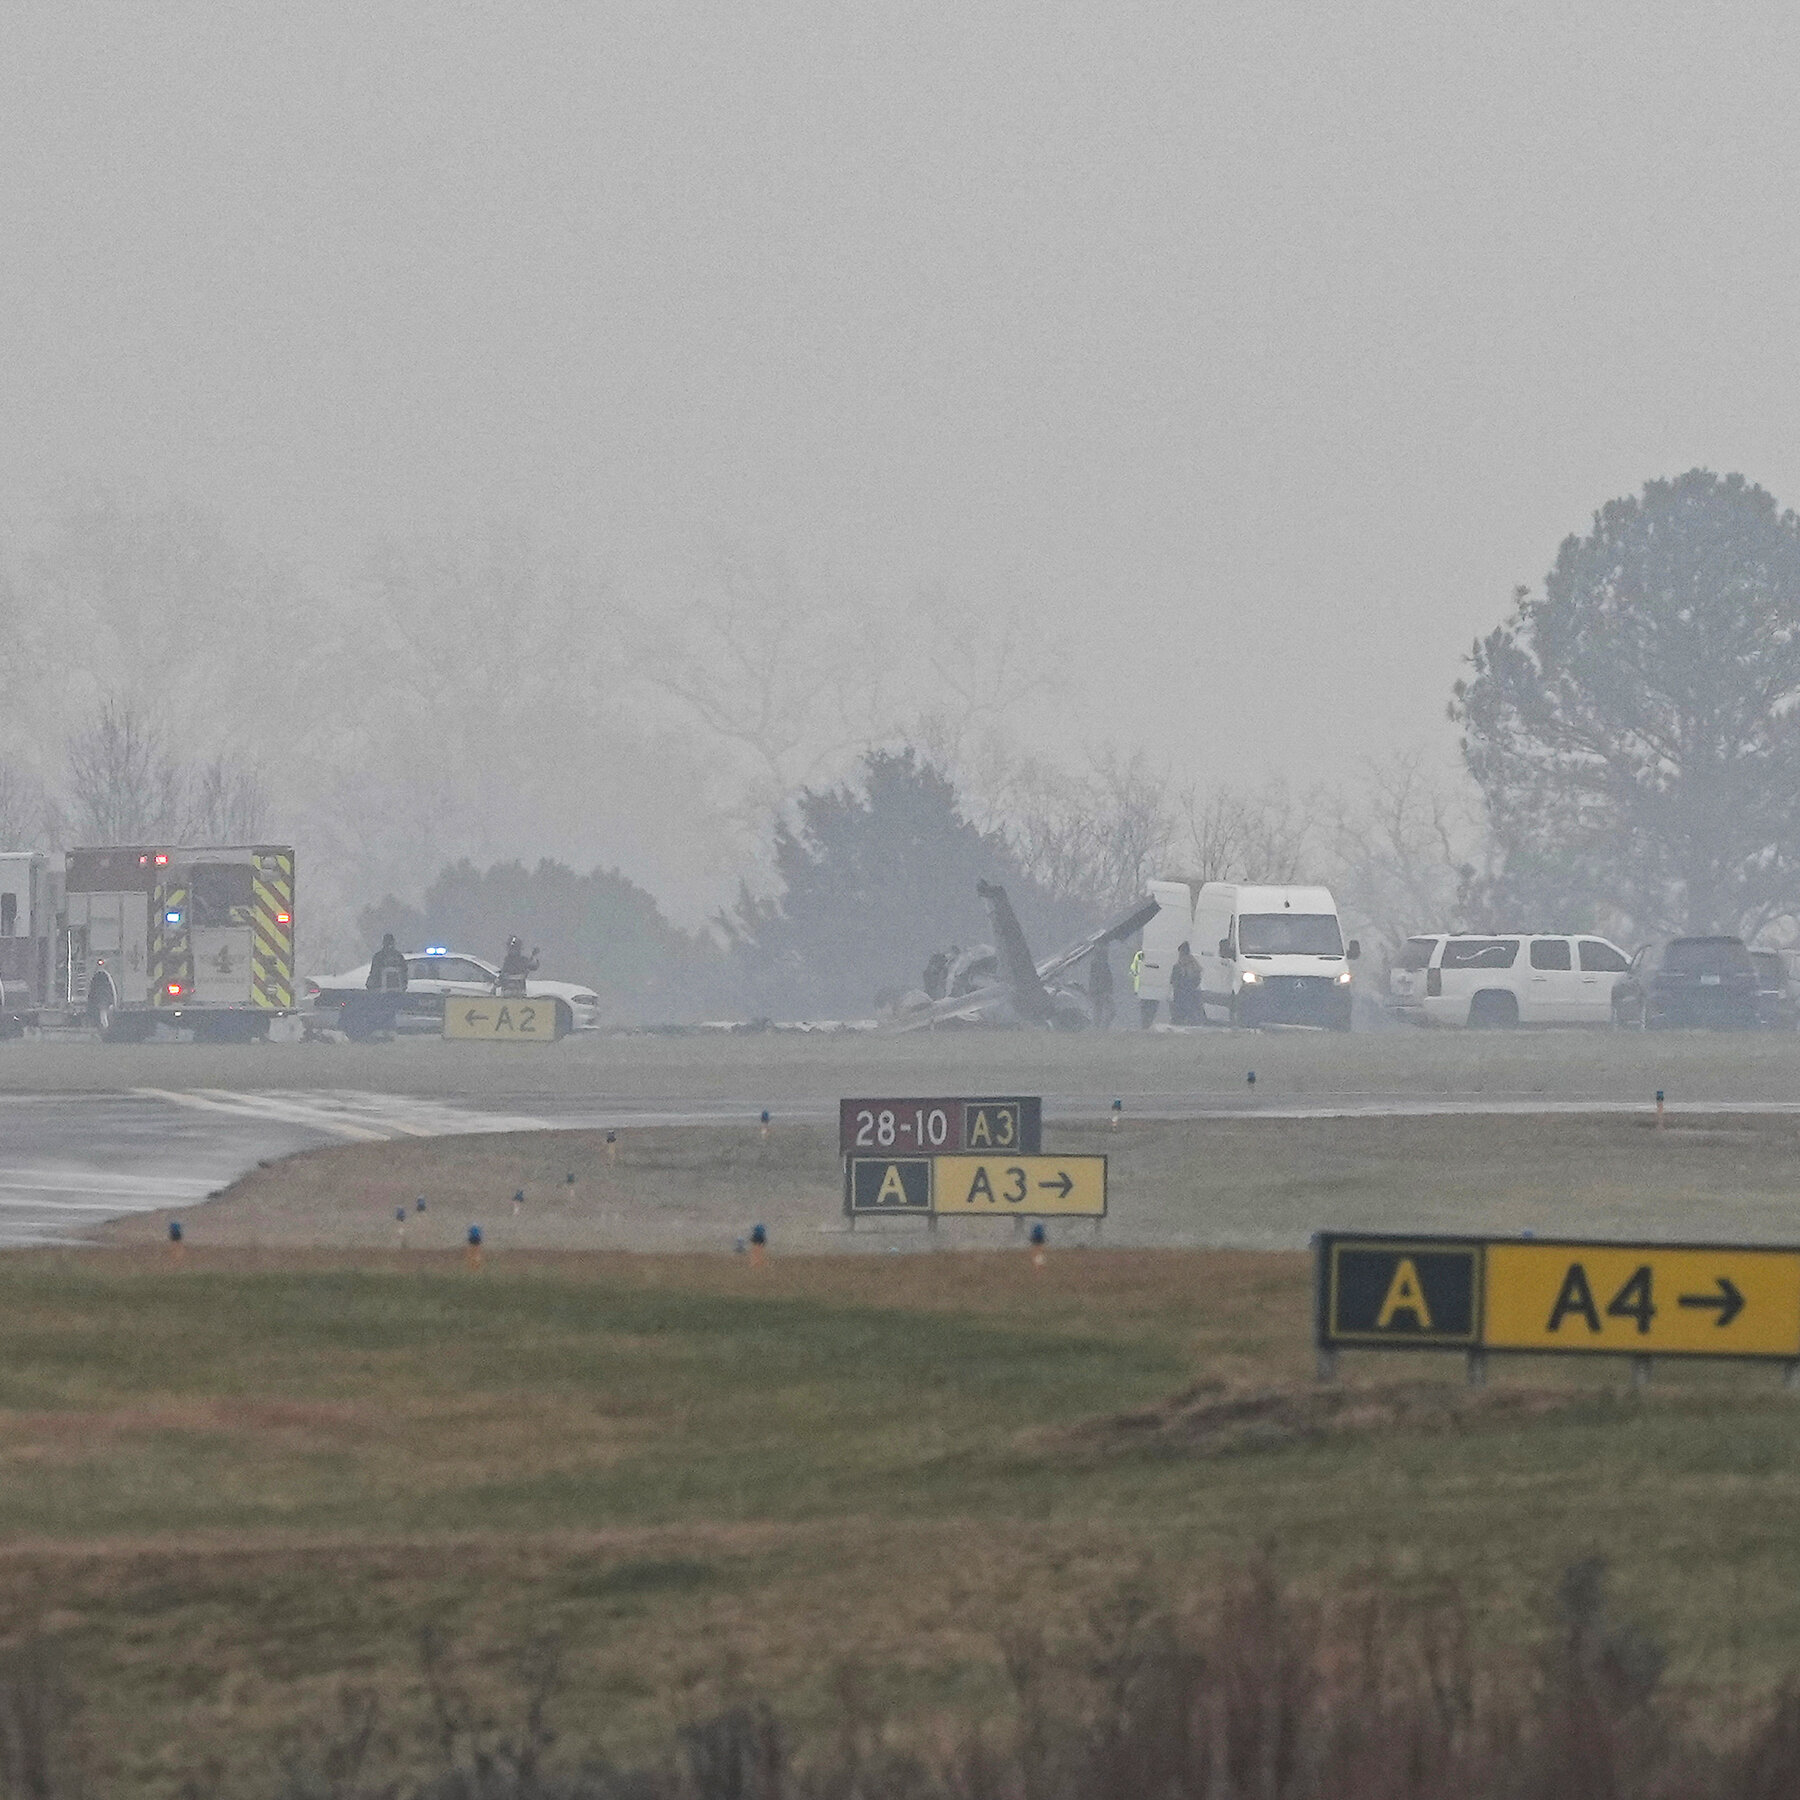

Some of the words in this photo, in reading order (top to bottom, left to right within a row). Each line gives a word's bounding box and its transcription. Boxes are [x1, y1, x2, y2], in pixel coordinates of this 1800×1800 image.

[495, 1005, 536, 1032] A2
[856, 1108, 948, 1147] 28-10
[970, 1109, 1014, 1146] A3
[876, 1164, 908, 1204] A
[966, 1166, 1028, 1204] A3
[1377, 1258, 1431, 1328] A
[1545, 1262, 1658, 1334] A4
